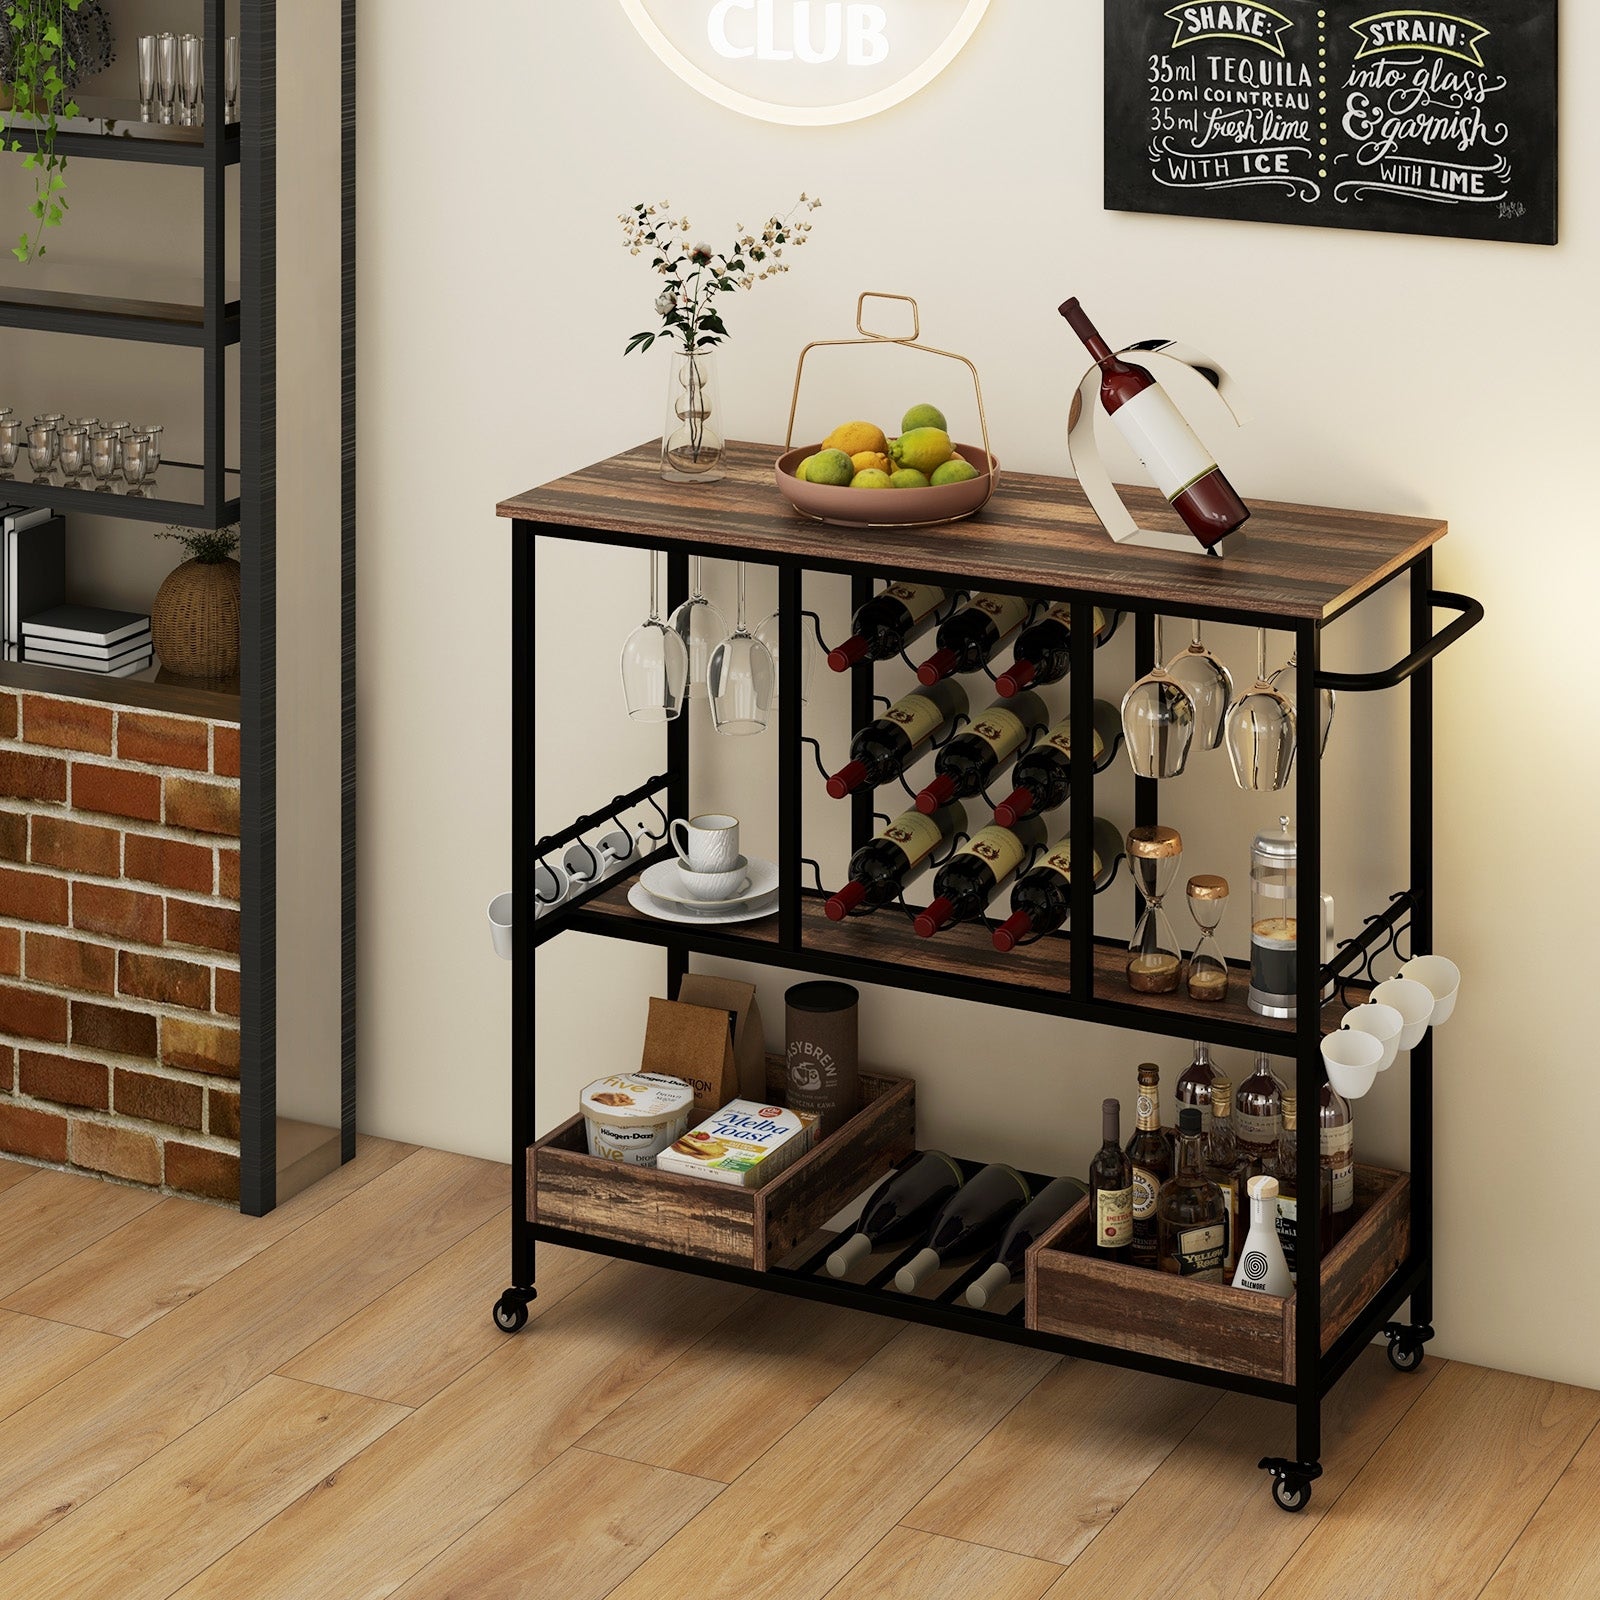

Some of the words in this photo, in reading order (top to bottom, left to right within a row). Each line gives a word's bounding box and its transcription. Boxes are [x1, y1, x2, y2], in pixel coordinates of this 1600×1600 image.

[707, 0, 889, 66] CLUB
[1184, 5, 1272, 37] SHAKE:
[1369, 19, 1465, 47] STRAIN:
[1207, 56, 1312, 88] TEQUILA
[1341, 55, 1422, 89] into
[1388, 57, 1507, 115] glass
[1203, 87, 1310, 110] COINTREAU
[1191, 107, 1260, 148] fresh
[1259, 109, 1311, 145] lime
[1342, 92, 1384, 140] &
[1357, 106, 1508, 164] garnish
[1168, 157, 1230, 180] WITH
[1243, 154, 1289, 173] ICE
[1380, 163, 1422, 186] WITH
[1429, 166, 1485, 195] LIME
[603, 1075, 649, 1092] five
[712, 1113, 790, 1136] Melba
[712, 1123, 774, 1143] Toast
[594, 1136, 625, 1162] five
